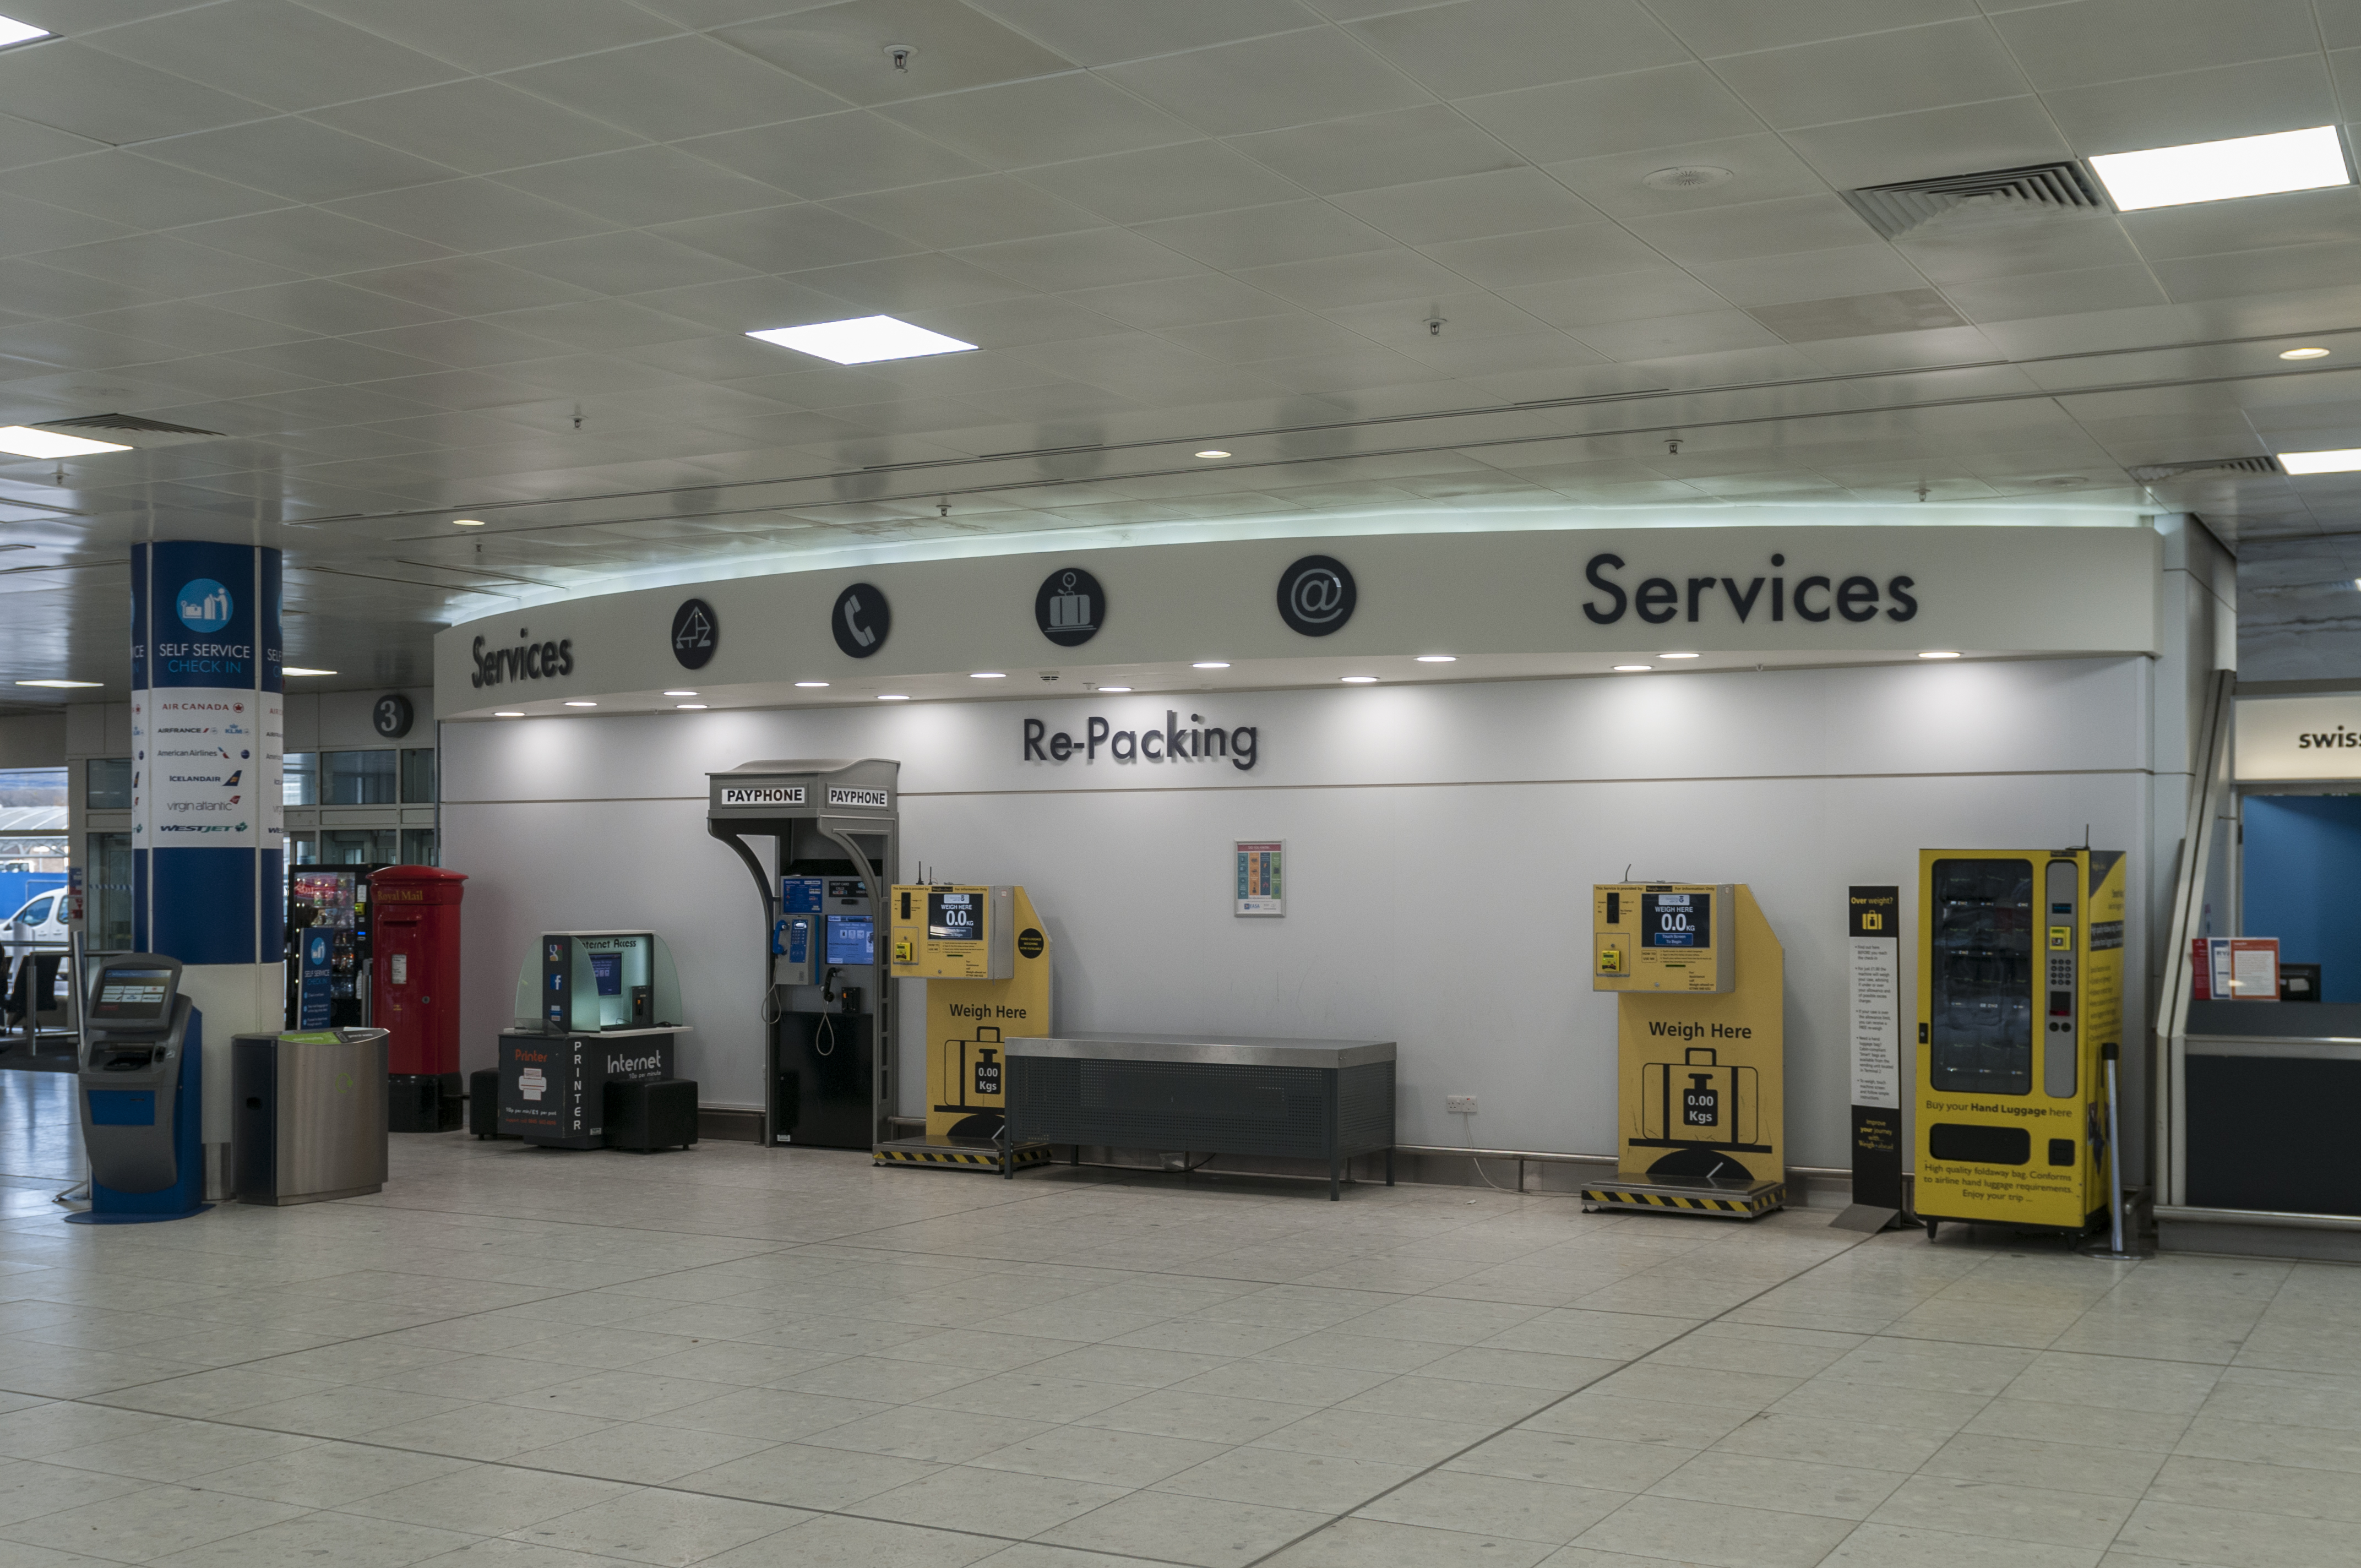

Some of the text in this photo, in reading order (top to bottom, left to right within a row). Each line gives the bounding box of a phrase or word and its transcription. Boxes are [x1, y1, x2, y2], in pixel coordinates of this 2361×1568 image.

[1582, 553, 1918, 624] Services
[159, 644, 189, 657] SELF
[193, 644, 250, 658] SERVICE
[471, 628, 571, 688] Services
[168, 660, 241, 673] CHECK IN
[379, 700, 397, 732] 3
[1024, 710, 1257, 770] Re-Packing
[2299, 725, 2361, 748] swis
[727, 789, 802, 802] PAYPHONE
[830, 790, 885, 805] PAYPHONE
[167, 801, 232, 812] virgin atlantic
[377, 890, 423, 903] Royal Mail
[1868, 897, 1893, 906] weight?
[946, 910, 967, 926] 0.0
[1661, 913, 1687, 931] 0.0
[614, 939, 637, 948] Access
[950, 1004, 1026, 1020] Weigh Here
[1649, 1021, 1752, 1041] Weigh Here
[515, 1049, 548, 1062] Printer
[607, 1050, 661, 1074] Internet
[978, 1068, 998, 1077] 0.00
[573, 1041, 582, 1130] PRINTER
[980, 1081, 997, 1092] Kgs
[1688, 1095, 1714, 1106] 0.00
[1926, 1101, 2072, 1117] Buy your Hand Luggage here
[1689, 1111, 1712, 1124] Kgs
[1925, 1163, 2071, 1181] High quality foldaway bag. Conforms
[1935, 1176, 1959, 1185] airline
[1962, 1178, 1982, 1186] hand
[1984, 1179, 2013, 1190] luggage
[2016, 1183, 2073, 1193] requirements.
[1962, 1189, 1984, 1200] Enjoy
[2009, 1193, 2023, 1202] trip
